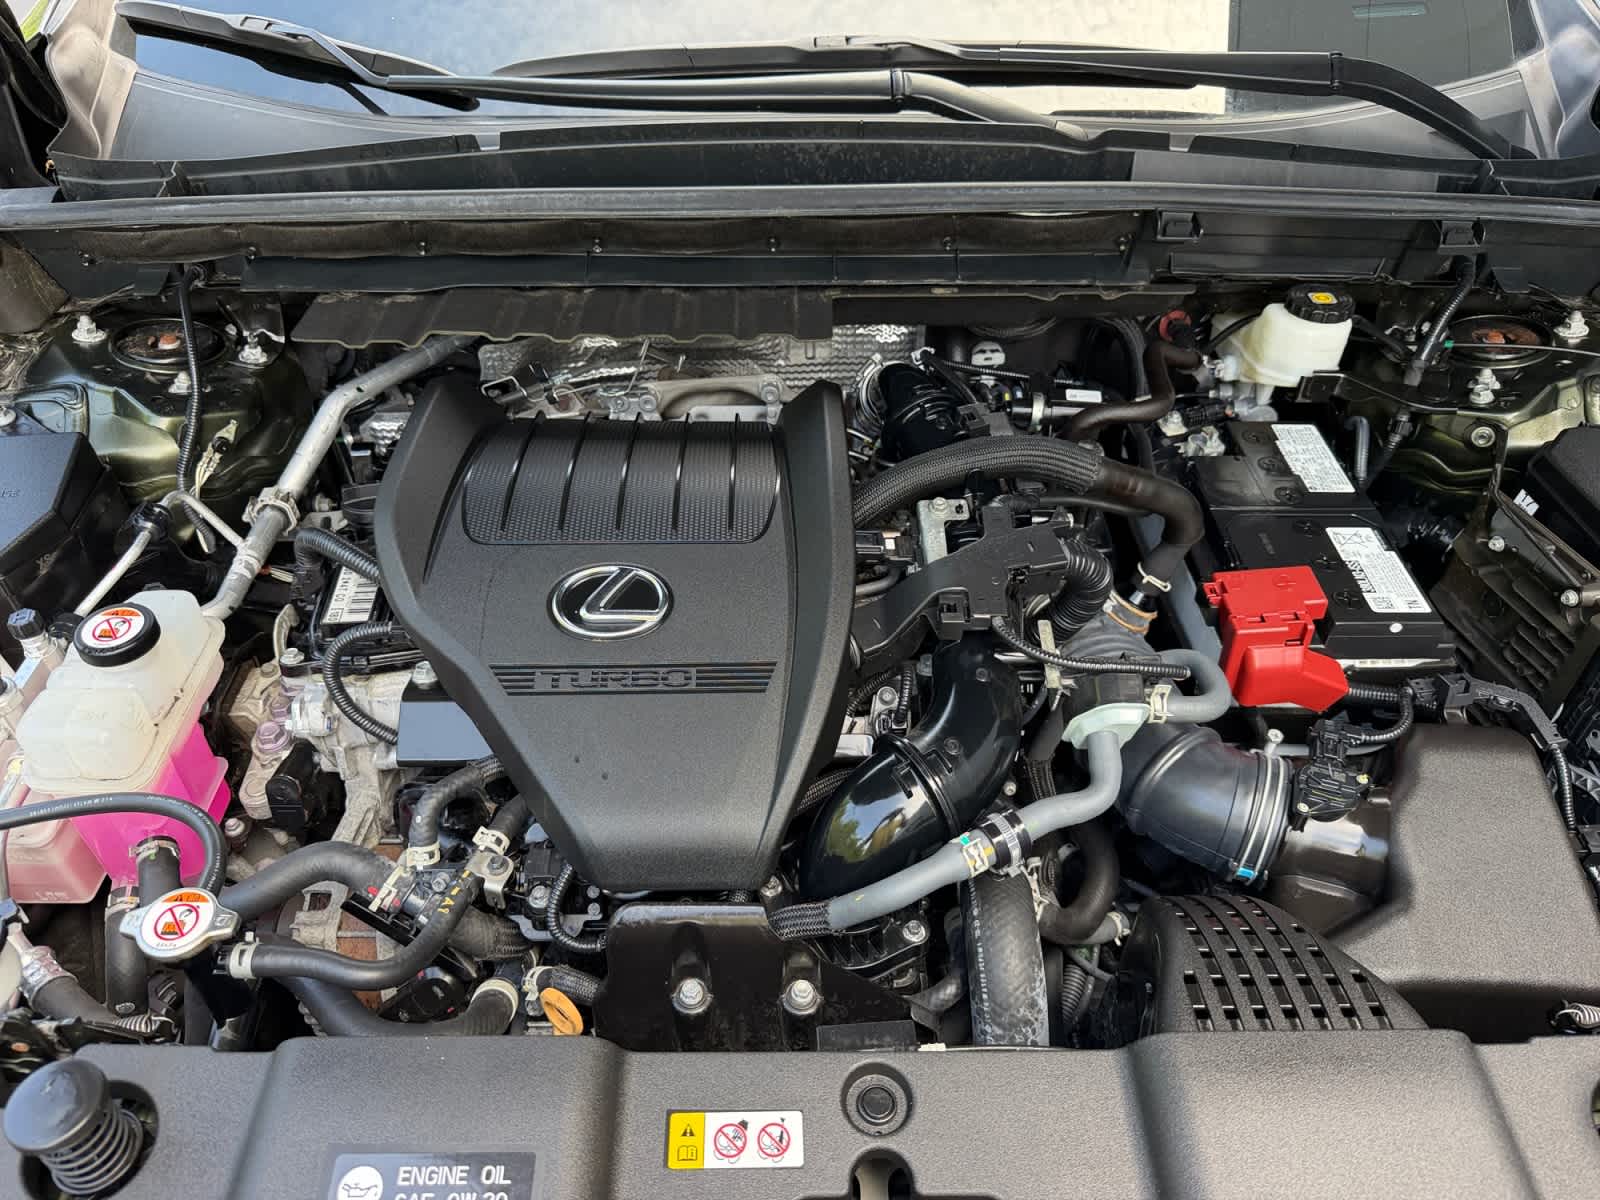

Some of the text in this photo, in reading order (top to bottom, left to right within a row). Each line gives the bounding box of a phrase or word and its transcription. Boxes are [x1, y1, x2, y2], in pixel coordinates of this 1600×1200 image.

[540, 669, 693, 689] TURBO
[397, 1164, 512, 1186] ENGINE OIL
